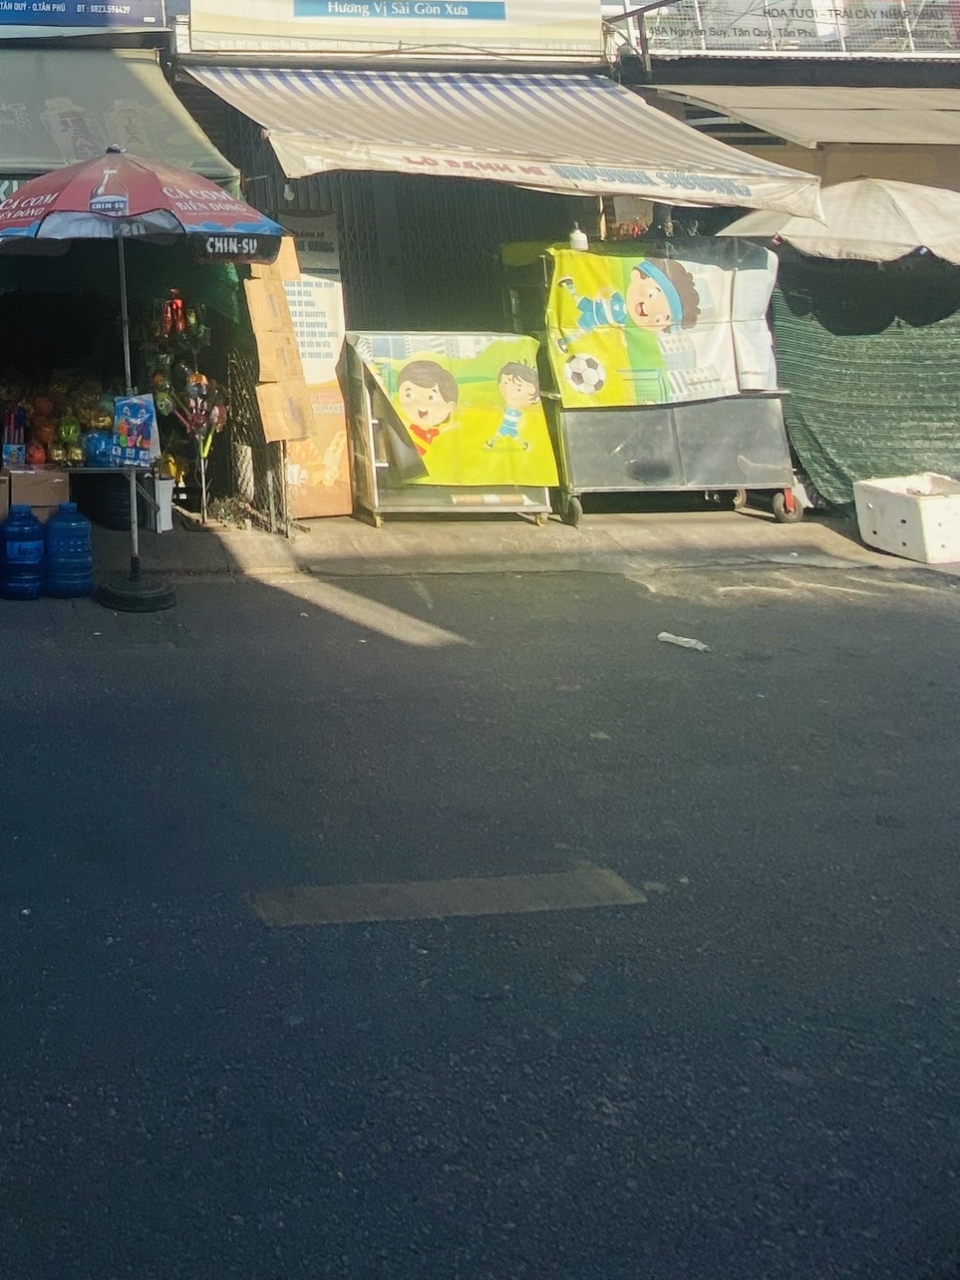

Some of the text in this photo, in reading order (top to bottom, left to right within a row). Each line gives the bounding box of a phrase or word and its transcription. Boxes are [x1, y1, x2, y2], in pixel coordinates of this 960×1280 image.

[328, 1, 469, 17] Hương Vị Sài Gòn Xưa
[763, 8, 789, 19] HOA
[91, 202, 125, 210] CHIN-SU
[206, 237, 258, 254] CHIN-SU
